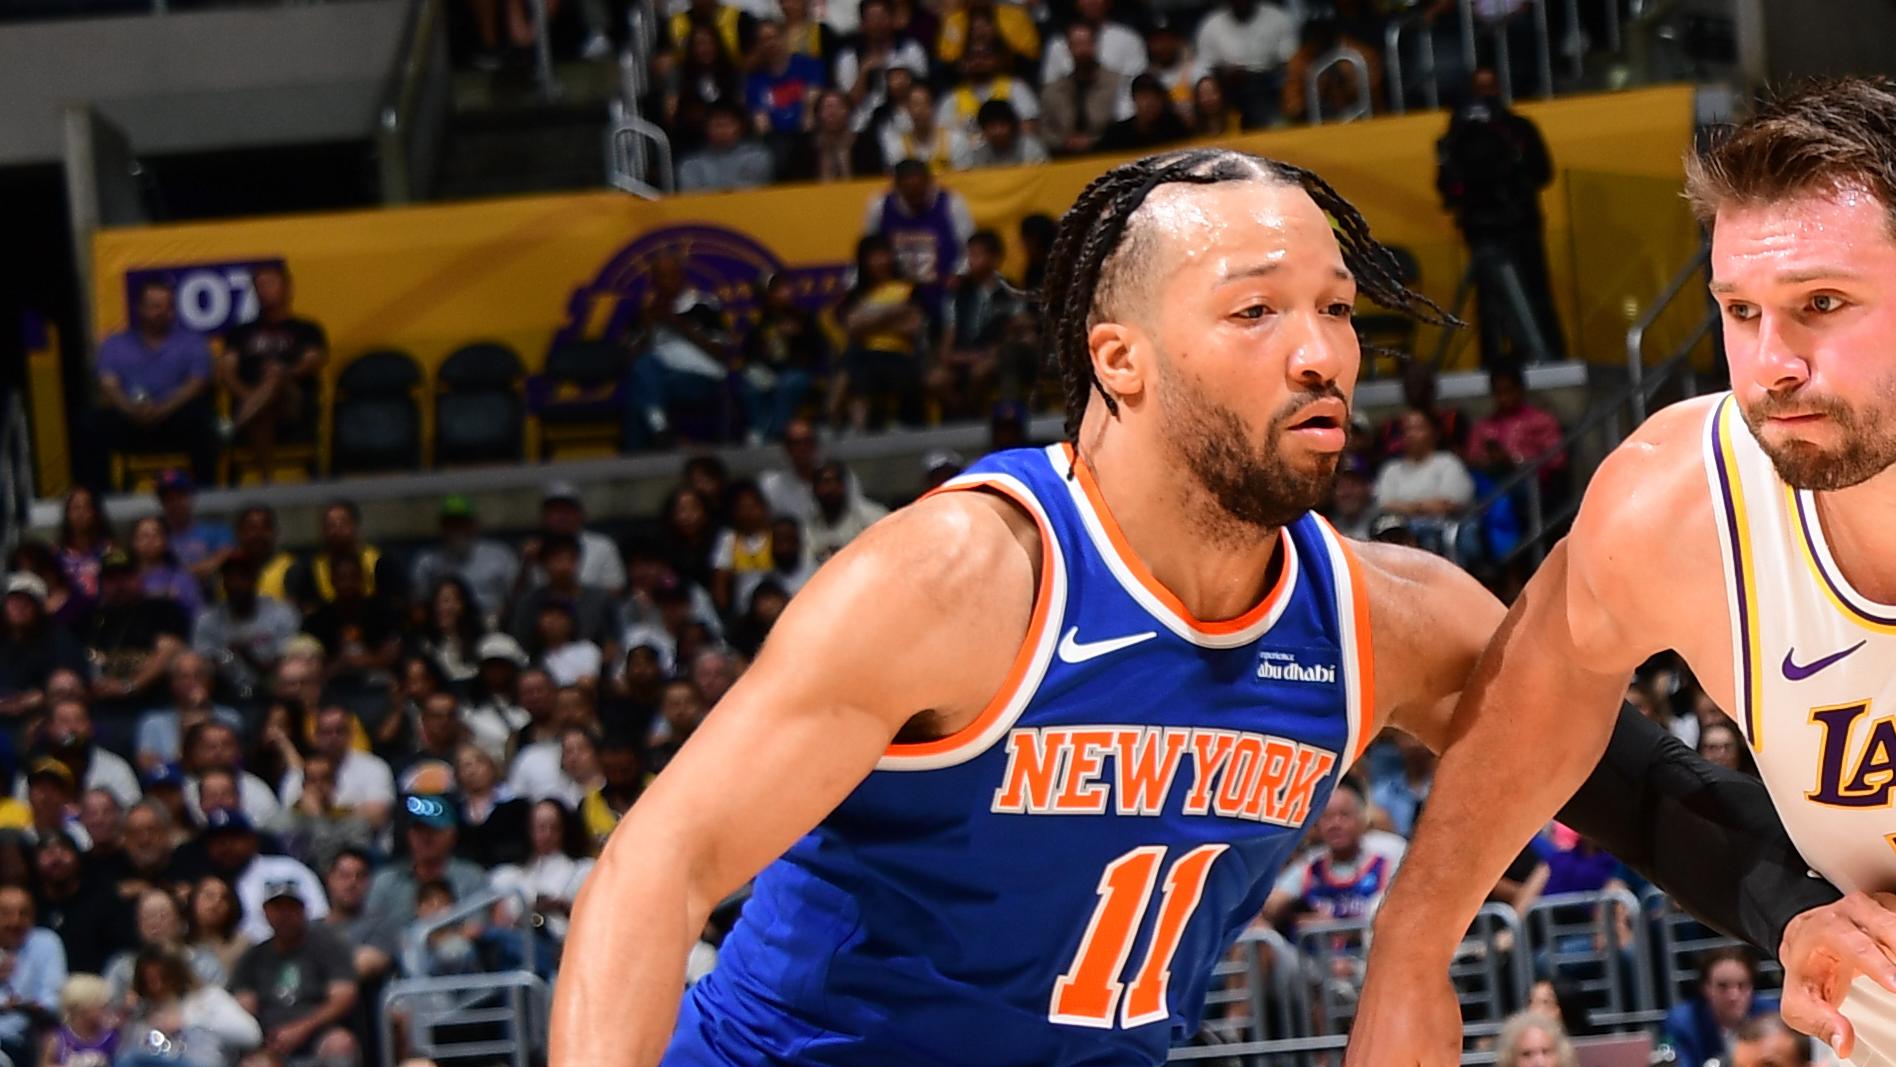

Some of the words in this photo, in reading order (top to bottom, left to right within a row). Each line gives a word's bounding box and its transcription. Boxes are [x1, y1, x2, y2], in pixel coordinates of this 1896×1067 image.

[178, 267, 261, 332] 07
[1257, 661, 1282, 680] abu
[1283, 662, 1336, 684] dhabi
[991, 726, 1189, 815] NEW
[1182, 726, 1338, 829] YORK
[1048, 843, 1231, 1030] 11
